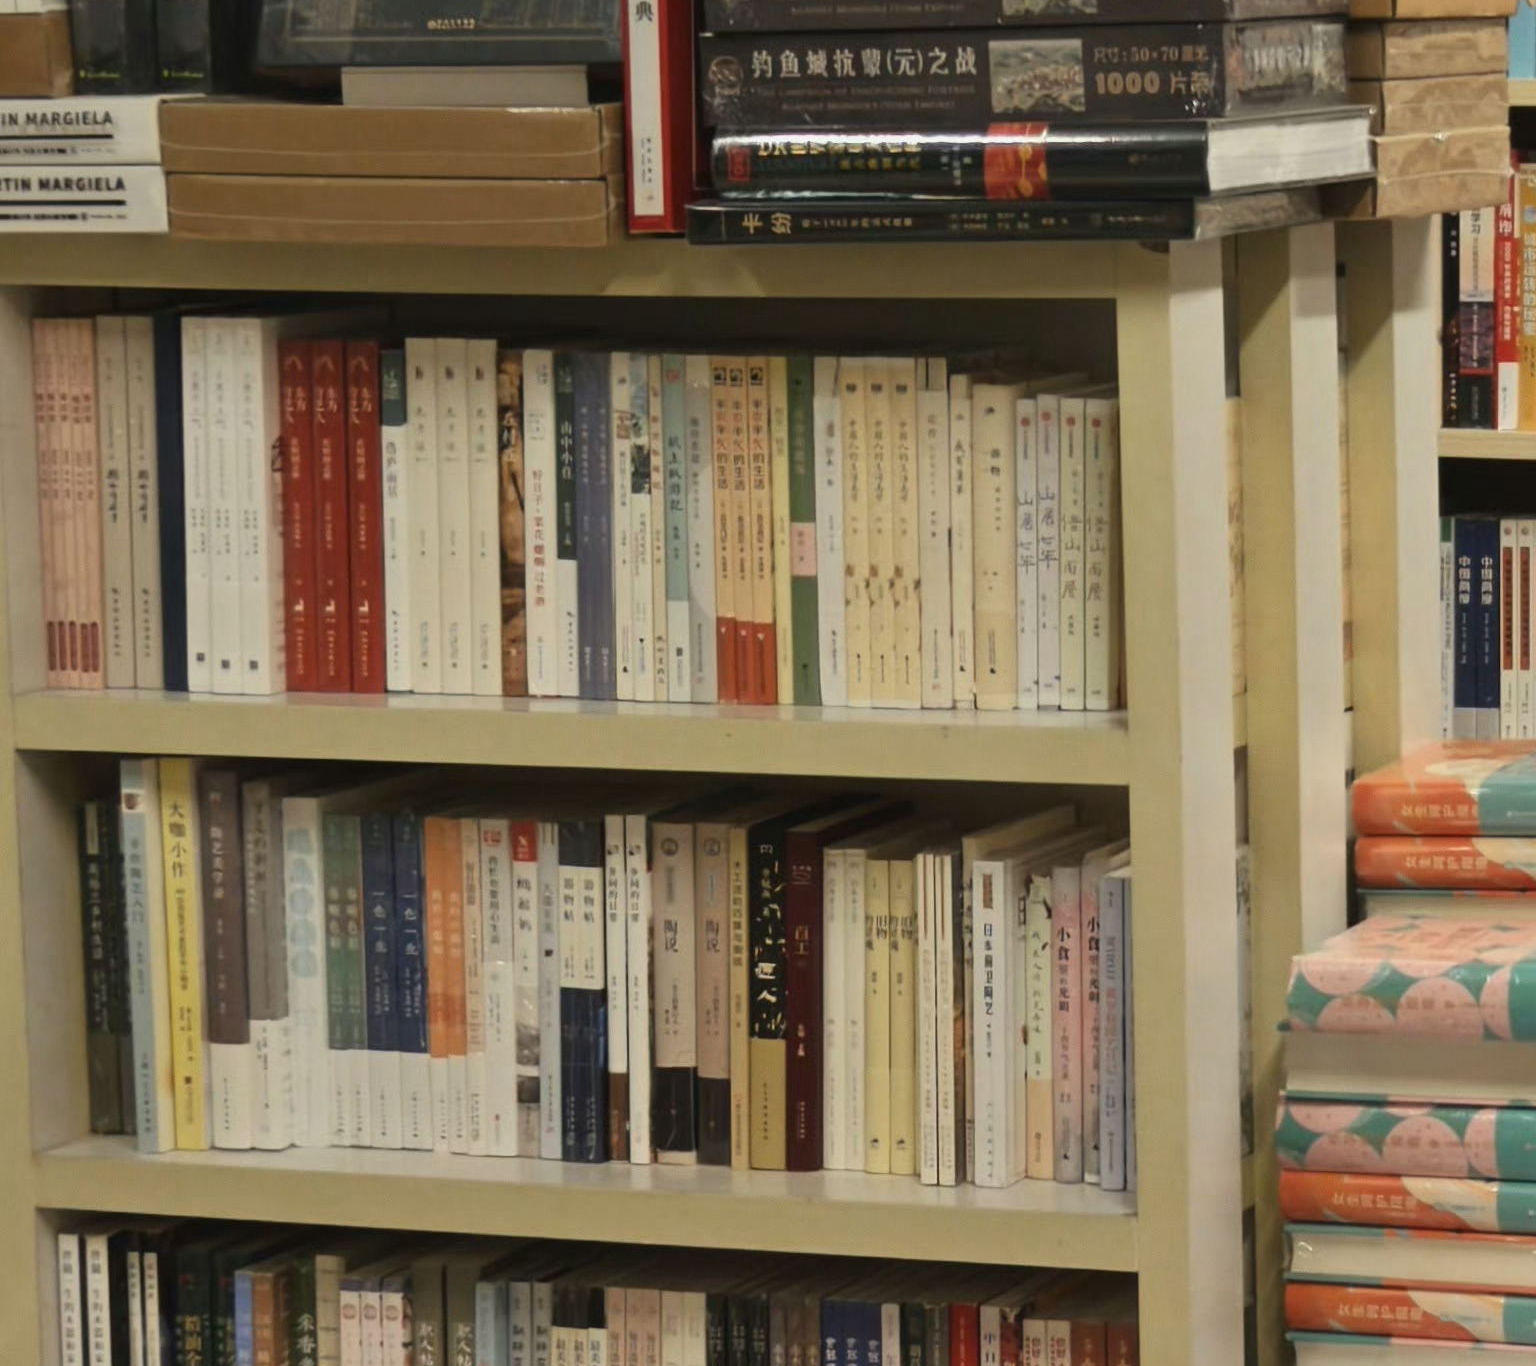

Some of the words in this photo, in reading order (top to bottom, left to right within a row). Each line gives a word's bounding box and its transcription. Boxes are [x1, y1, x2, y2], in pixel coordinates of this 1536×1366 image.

[1095, 70, 1160, 96] 1000
[26, 110, 113, 126] MARGIELA
[39, 176, 126, 192] MARGIELA
